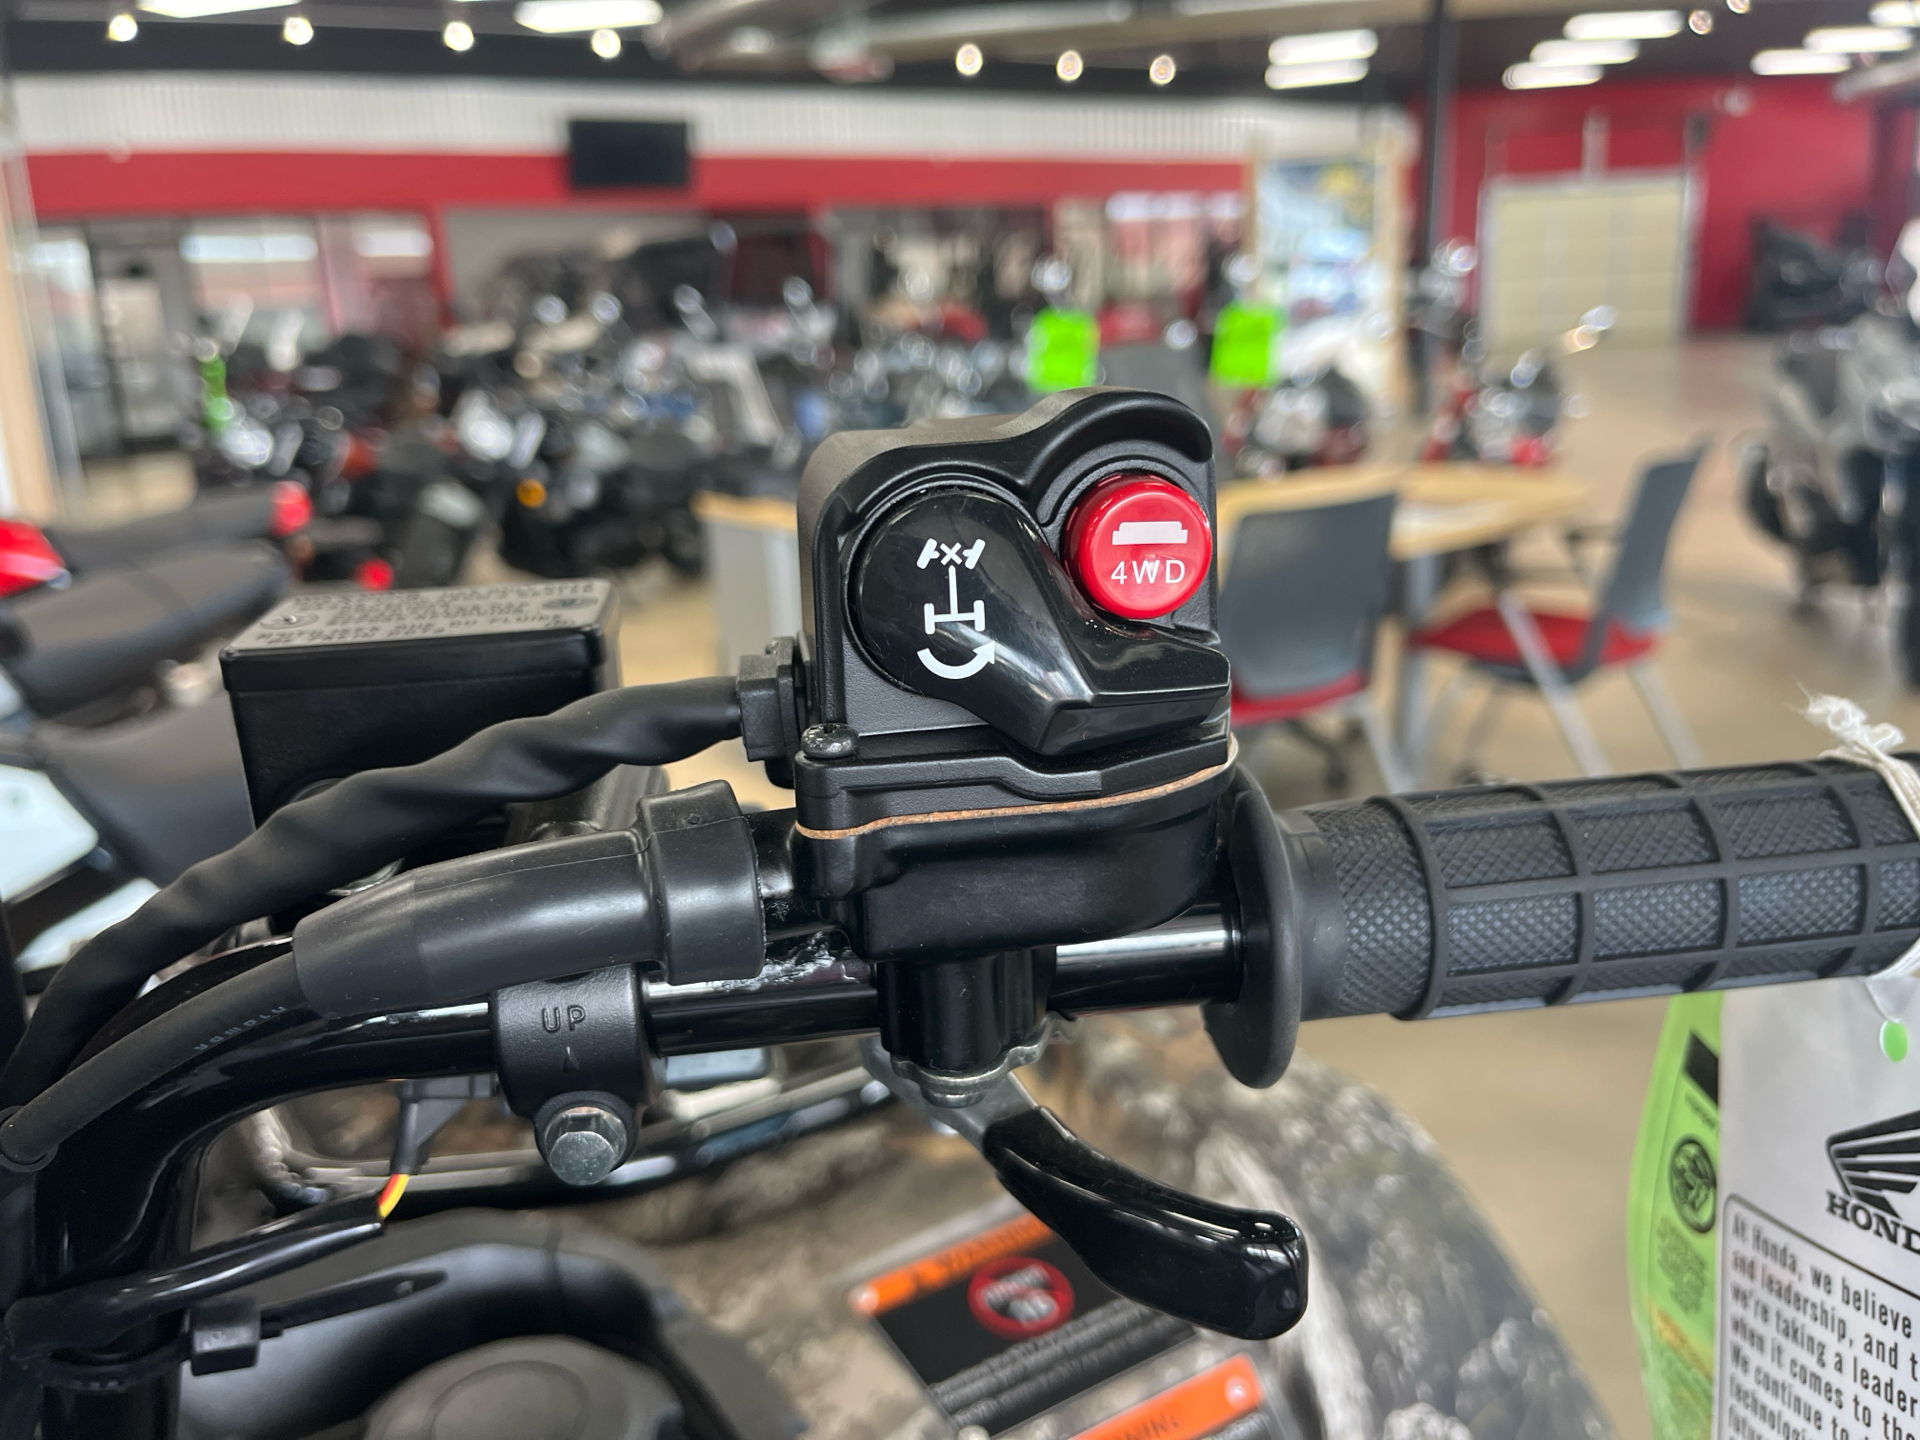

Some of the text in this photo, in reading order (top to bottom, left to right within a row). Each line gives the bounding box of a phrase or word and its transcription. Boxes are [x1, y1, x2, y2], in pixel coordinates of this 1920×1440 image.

[1110, 559, 1186, 585] 4WD
[541, 1004, 586, 1033] UP
[1761, 1263, 1854, 1349] leadership,
[1863, 1332, 1899, 1370] and
[1809, 1264, 1833, 1295] we
[1841, 1276, 1912, 1339] believe
[1775, 1308, 1827, 1369] taking
[1833, 1351, 1843, 1374] a
[1730, 1339, 1750, 1375] We
[1754, 1364, 1823, 1431] continue
[1831, 1415, 1850, 1440] to
[1771, 1336, 1783, 1369] it
[1789, 1356, 1844, 1410] comes
[1852, 1393, 1872, 1428] to
